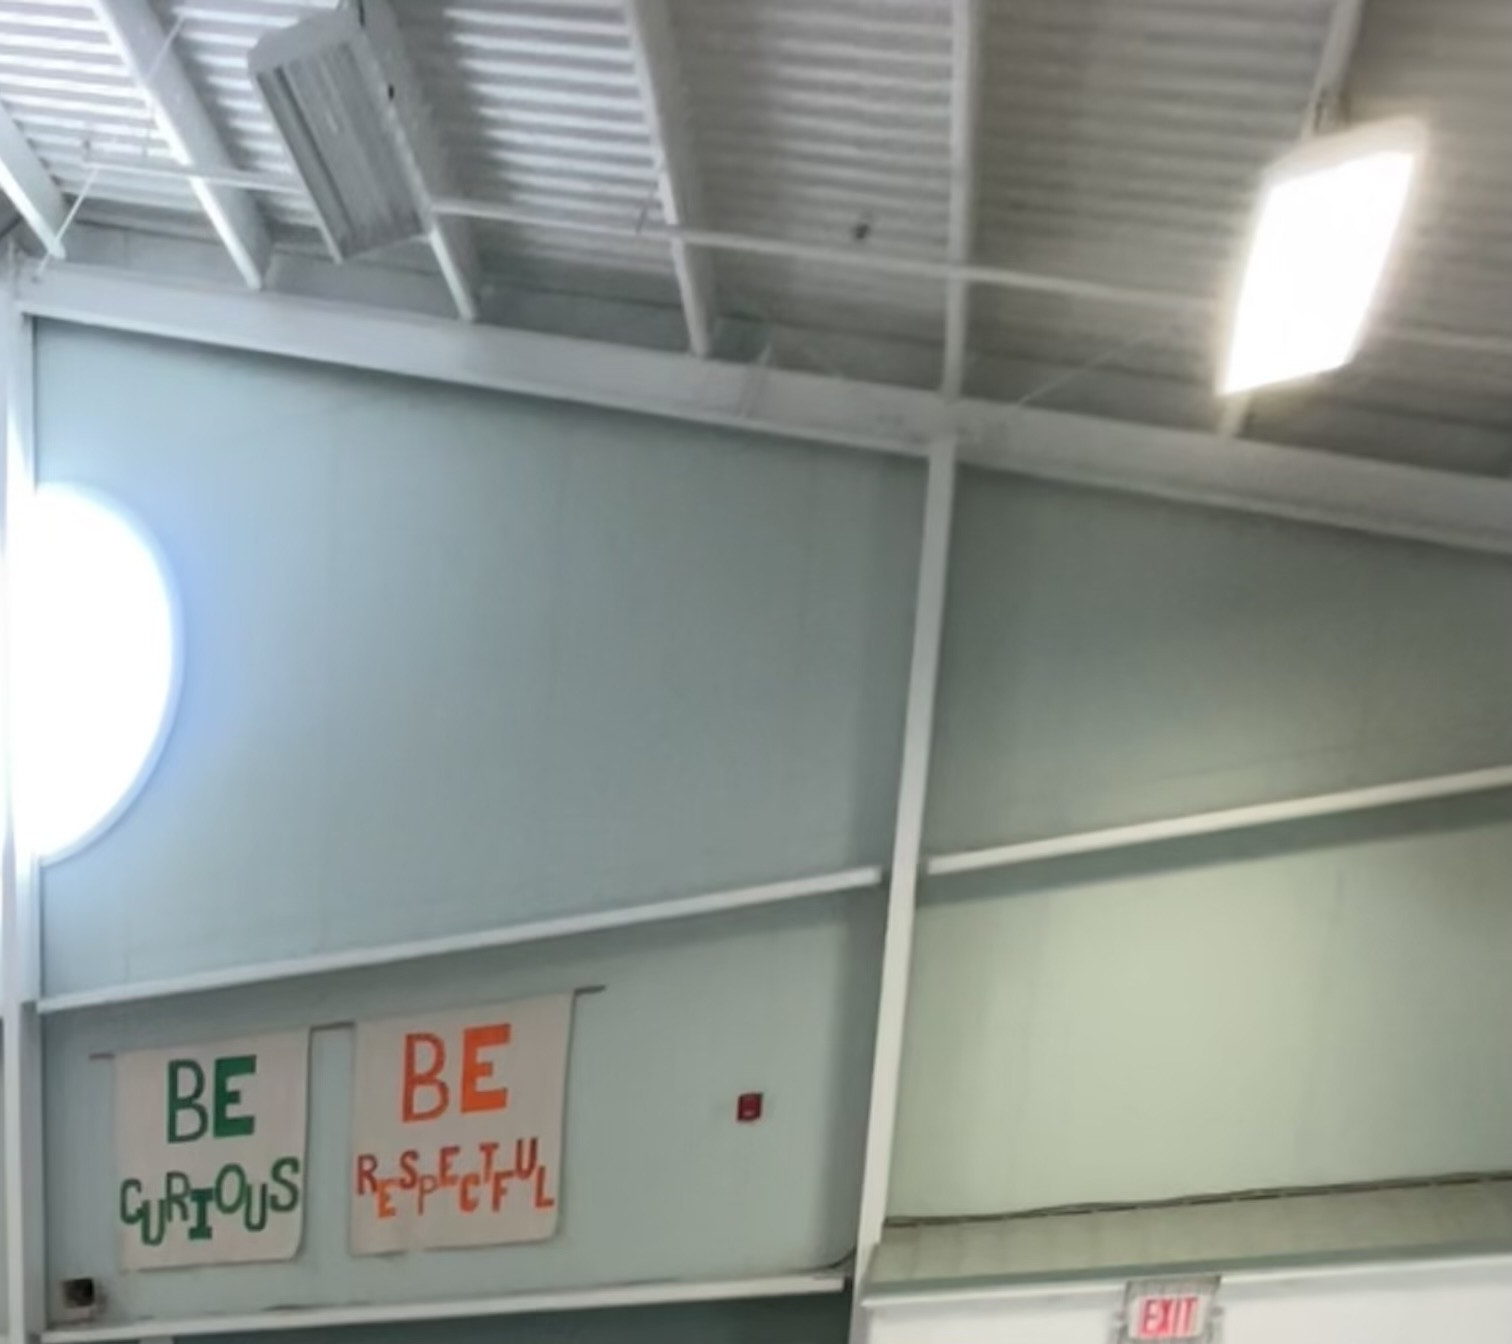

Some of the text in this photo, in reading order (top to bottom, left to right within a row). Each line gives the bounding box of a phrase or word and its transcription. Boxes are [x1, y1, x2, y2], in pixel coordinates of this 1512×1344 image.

[167, 1054, 257, 1144] BE
[402, 1022, 512, 1123] BE
[120, 1157, 300, 1247] CURIOUS
[357, 1137, 555, 1219] RESPECTFUL
[1141, 1296, 1199, 1338] EXIT
